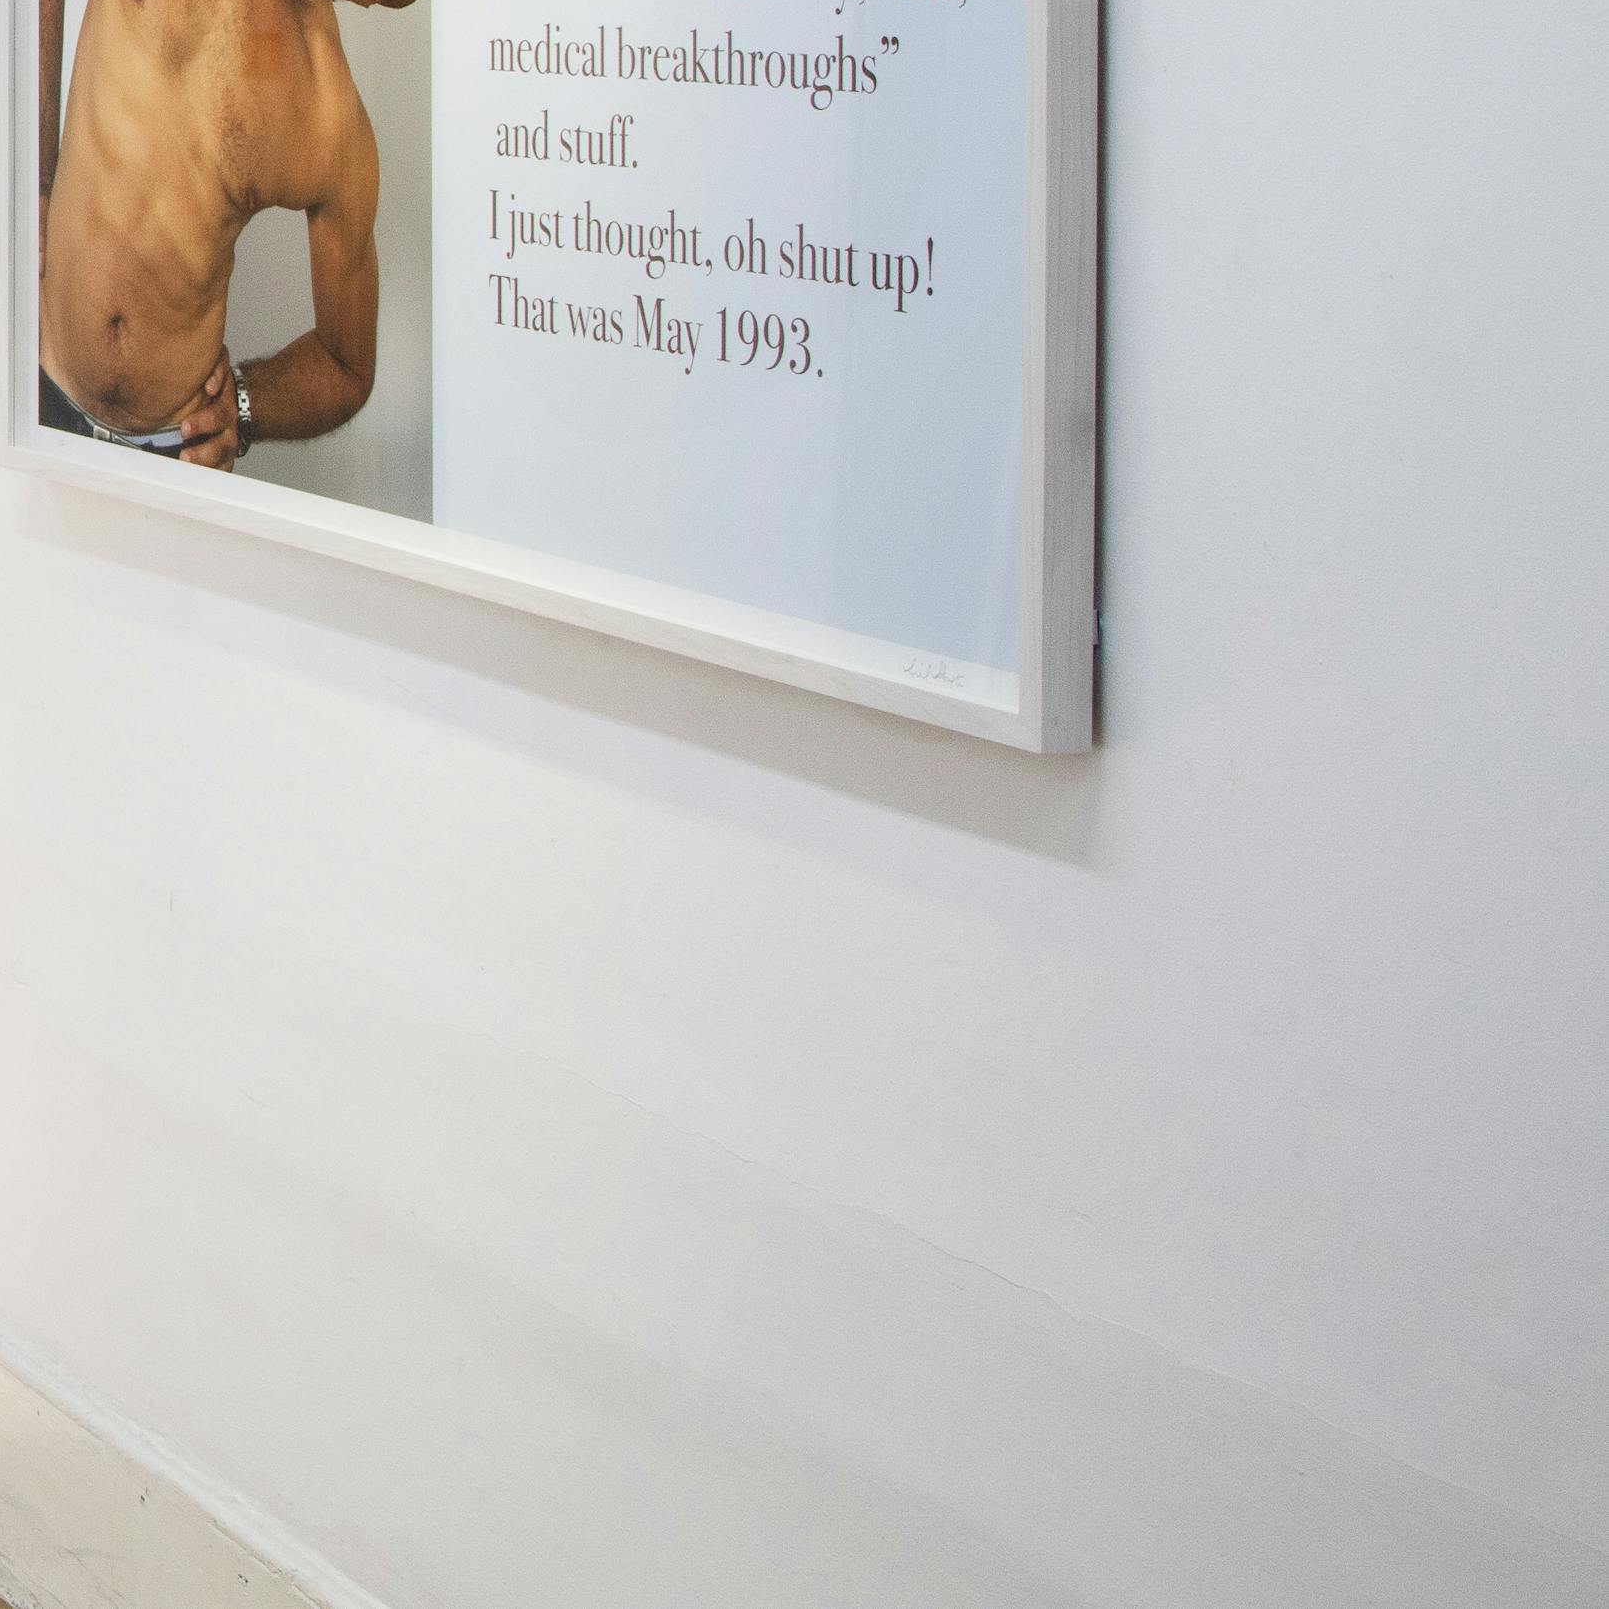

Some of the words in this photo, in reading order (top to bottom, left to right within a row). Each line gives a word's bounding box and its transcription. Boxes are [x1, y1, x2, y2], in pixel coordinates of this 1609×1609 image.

[488, 23, 606, 79] medical
[497, 111, 549, 160] and
[559, 114, 639, 169] stuff.
[488, 190, 498, 240] I
[506, 194, 565, 259] just
[573, 201, 713, 280] thought,
[723, 219, 767, 275] oh
[780, 224, 860, 287] shut
[871, 237, 934, 314] up!
[488, 274, 558, 334] That
[566, 302, 623, 345] was
[633, 295, 703, 376] May
[716, 307, 824, 378] 1993.
